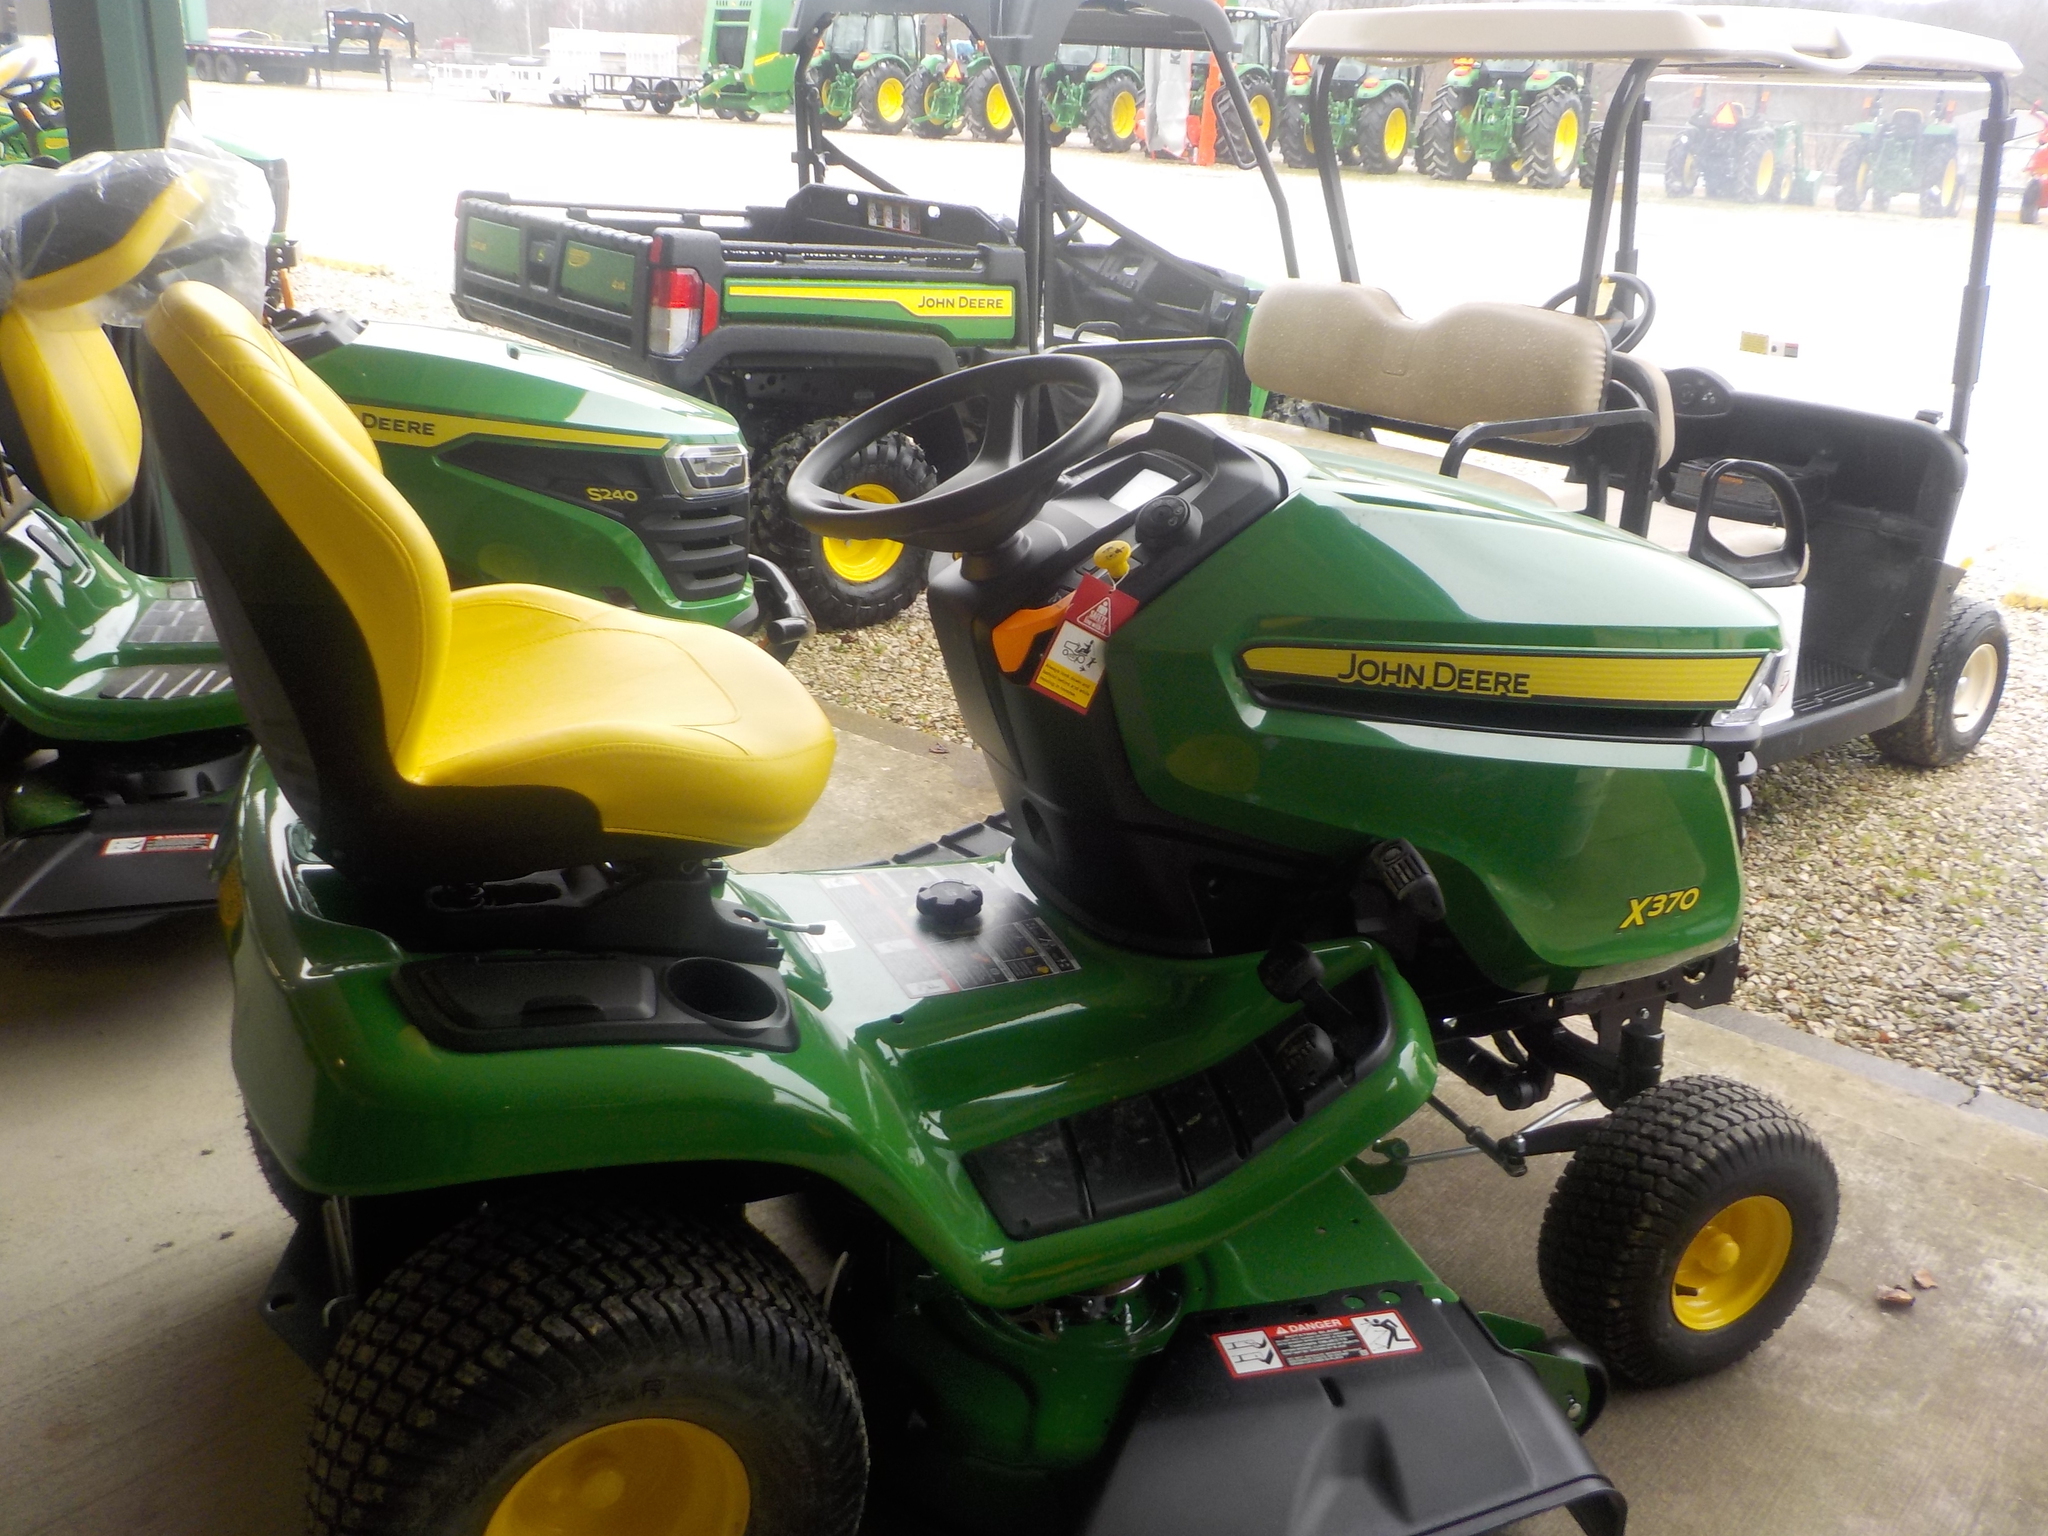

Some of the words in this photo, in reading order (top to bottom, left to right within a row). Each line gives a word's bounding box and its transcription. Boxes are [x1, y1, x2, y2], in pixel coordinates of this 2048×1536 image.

[918, 295, 955, 309] JOHN
[958, 296, 1004, 309] DEERE
[361, 412, 435, 436] DEERE
[586, 487, 638, 502] S240
[1338, 653, 1425, 686] JOHN
[1432, 661, 1531, 695] DEERE
[1618, 887, 1700, 929] X370
[1288, 1319, 1342, 1333] DANGER
